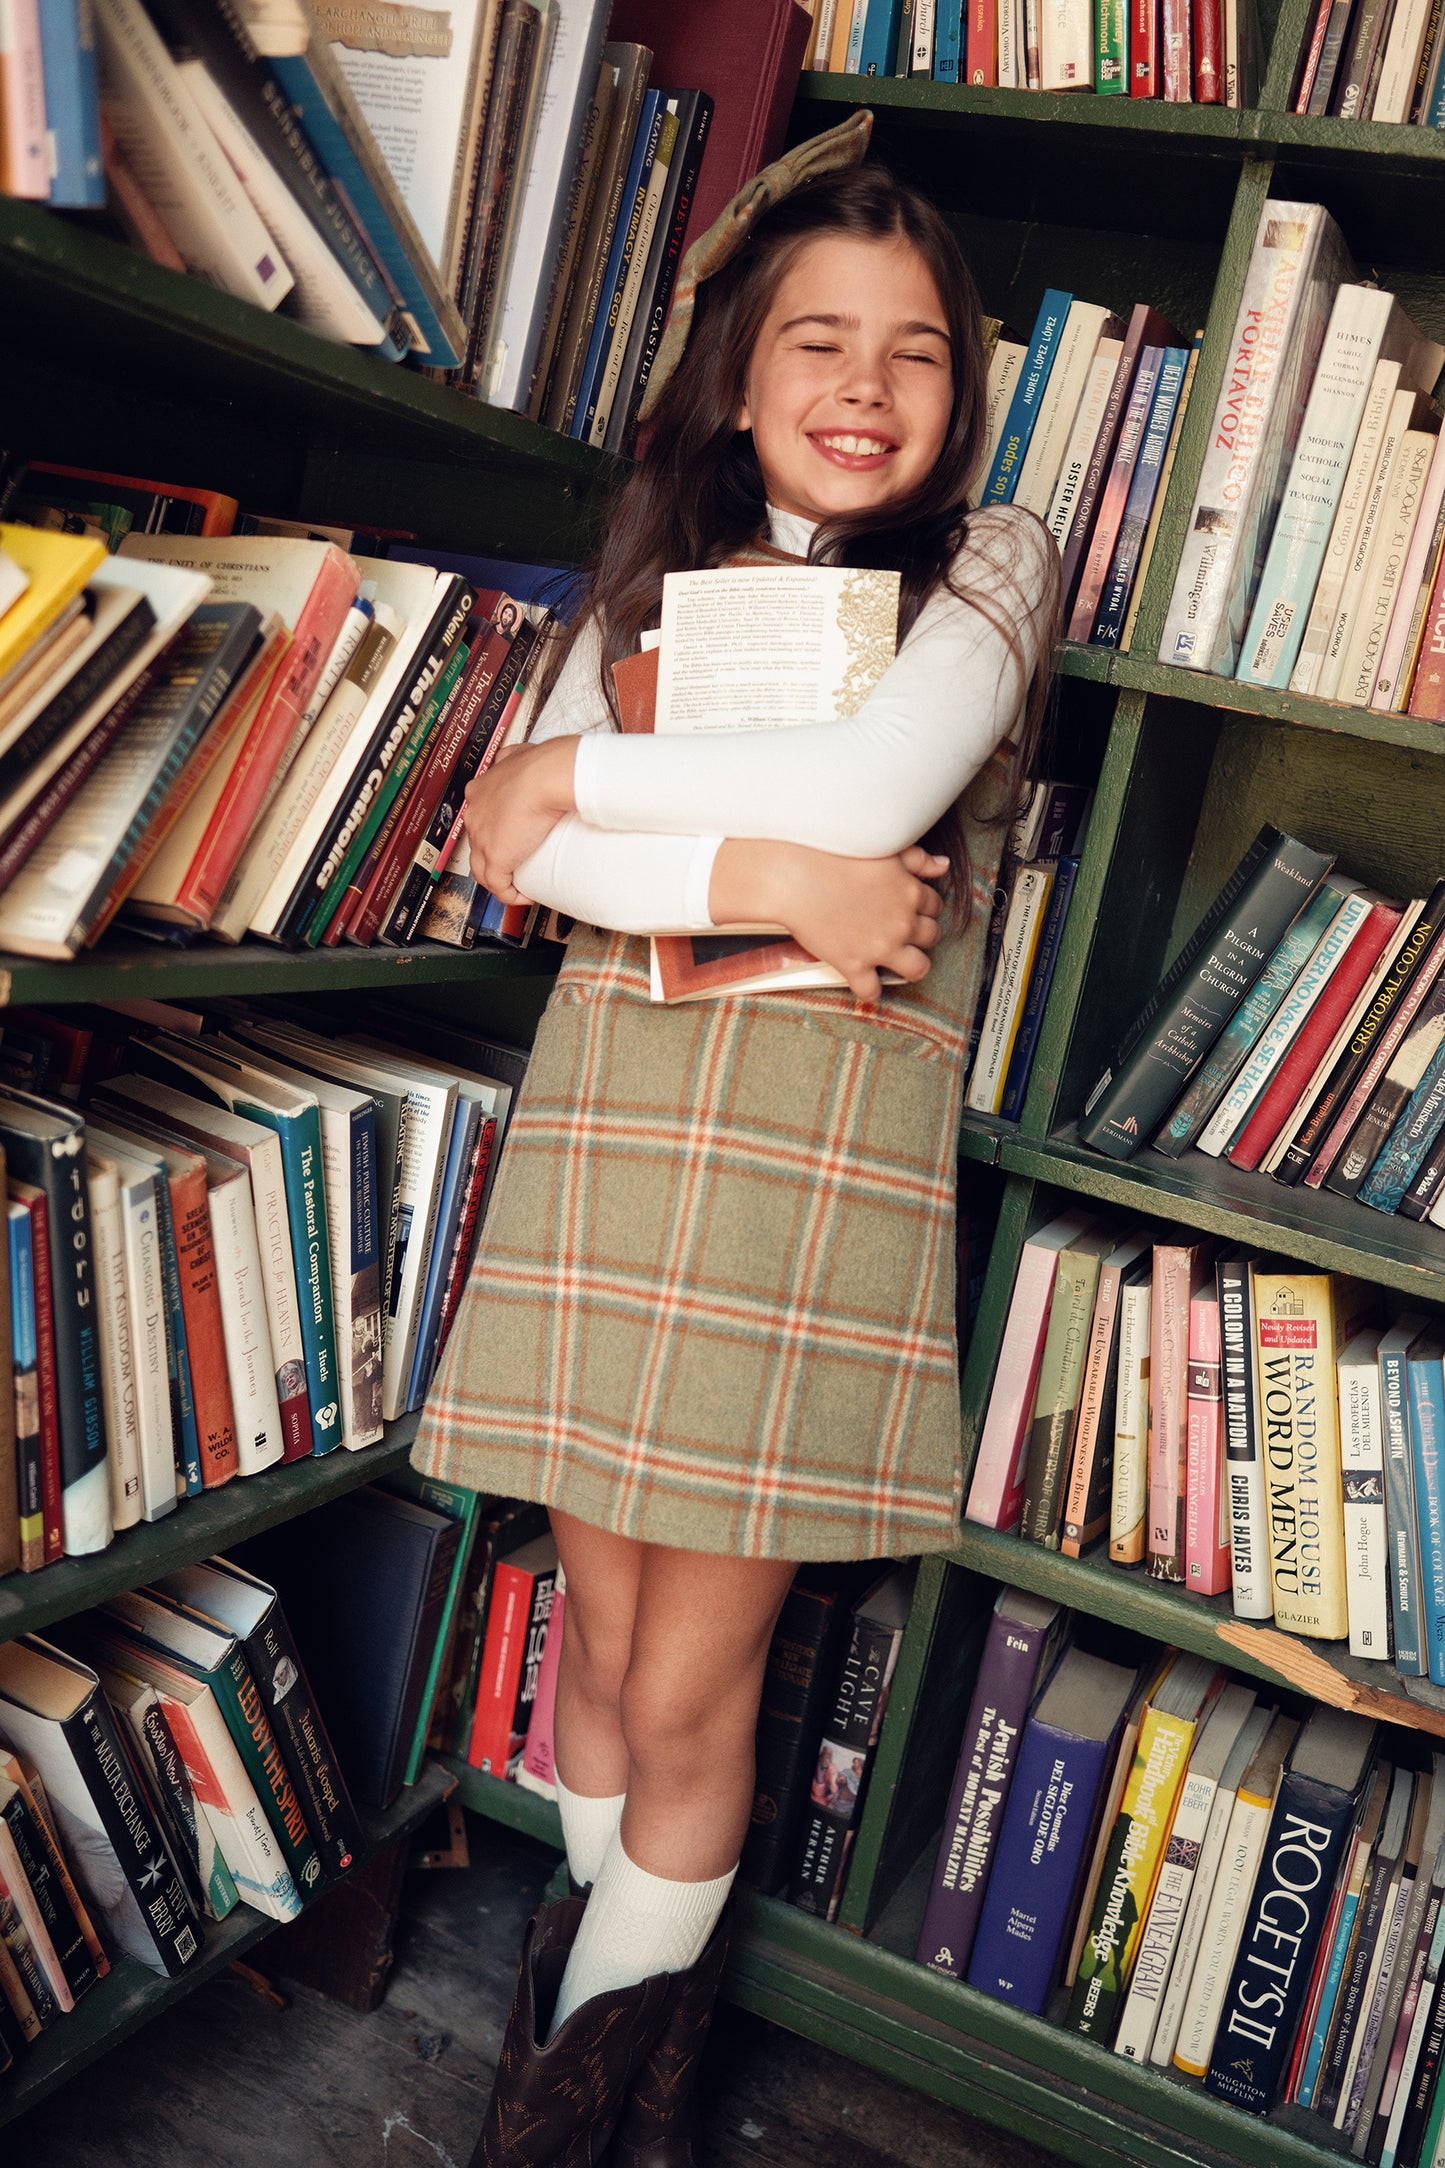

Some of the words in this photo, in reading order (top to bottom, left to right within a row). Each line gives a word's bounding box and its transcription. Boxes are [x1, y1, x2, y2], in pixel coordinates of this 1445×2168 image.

[852, 28, 860, 48] HAIN
[1355, 15, 1374, 60] Pearlman
[1227, 80, 1235, 101] Vida
[645, 112, 663, 168] KEATING
[698, 110, 709, 142] BURKE
[624, 186, 647, 264] INTIMACY
[669, 195, 688, 259] DEVIL
[609, 291, 622, 328] GOD
[640, 306, 664, 387] CASTLE
[1336, 331, 1374, 345] HIMES
[1024, 370, 1039, 404] ANDRÉS
[1034, 344, 1049, 370] LÓPEZ
[1043, 316, 1057, 341] LÓPEZ
[1109, 354, 1130, 400] Believing
[1135, 368, 1154, 393] DEATH
[1159, 363, 1181, 393] DEATH
[1216, 308, 1264, 451] PORTAVOZ
[1128, 404, 1144, 420] THE
[1132, 393, 1148, 404] ON
[1149, 392, 1174, 431] WASHES
[1090, 419, 1112, 466] Revealing
[1116, 420, 1140, 464] BOARDWALK
[1140, 432, 1164, 467] ASHORE
[1298, 453, 1343, 470] CATHOLIC
[1307, 436, 1346, 450] MODERN
[994, 476, 1008, 495] los
[1002, 435, 1020, 472] sapos
[1061, 461, 1081, 503] SISTER
[1086, 467, 1099, 489] God
[1300, 472, 1332, 486] SOCIAL
[1072, 495, 1091, 538] MORAN
[1288, 490, 1333, 508] TEACHING
[1367, 485, 1384, 527] MISTERIO
[1353, 527, 1372, 572] RELIGIOSO
[1187, 542, 1218, 620] Willmington
[442, 594, 473, 648] O'Neill
[1331, 612, 1348, 658] WOODROW
[410, 654, 444, 706] The
[474, 669, 493, 694] The
[489, 635, 528, 712] INTERIOR
[459, 693, 482, 726] Inner
[380, 703, 416, 769] New
[438, 724, 467, 773] Journey
[462, 713, 494, 772] CASTLE
[316, 768, 384, 890] Catholics
[1273, 858, 1314, 888] Weakland
[1022, 904, 1030, 917] THE
[1338, 897, 1364, 928] UN
[1013, 919, 1027, 959] UNIVERSITY
[1224, 929, 1265, 960] PILGRIM
[1248, 927, 1259, 938] A
[1306, 923, 1348, 980] LIDER
[1010, 959, 1018, 970] OF
[1207, 955, 1248, 985] PILGRIM
[1227, 951, 1238, 961] IN
[1003, 970, 1016, 1005] CHICAGO
[1199, 969, 1240, 998] CHURCH
[1293, 972, 1320, 1003] NO
[1348, 972, 1403, 1056] CRISTOBAL
[1393, 919, 1433, 976] COLON
[996, 1005, 1008, 1035] SPANISH
[1263, 995, 1304, 1048] NACE,
[986, 1035, 1001, 1079] DICTIONARY
[1252, 1041, 1276, 1069] SE
[1226, 1063, 1263, 1112] HACE
[1299, 1126, 1316, 1145] Kay
[1309, 1090, 1337, 1128] Brigham
[301, 1146, 311, 1177] The
[361, 1131, 369, 1168] JEWISH
[1287, 1151, 1304, 1165] CLIE
[303, 1180, 319, 1239] Pastoral
[362, 1170, 370, 1208] PUBLIC
[265, 1190, 284, 1267] PRACTICE
[363, 1208, 371, 1254] CULTURE
[234, 1266, 250, 1308] Bread
[272, 1270, 284, 1284] for
[308, 1241, 324, 1324] Companion
[1100, 1277, 1112, 1302] DELIO
[1221, 1276, 1239, 1288] A
[275, 1289, 293, 1349] HEAVEN
[1221, 1292, 1244, 1353] COLONY
[80, 1327, 96, 1391] WILLIAM
[241, 1346, 257, 1397] Journey
[318, 1349, 328, 1382] Huels
[1224, 1356, 1244, 1374] IN
[1226, 1376, 1244, 1388] A
[1386, 1359, 1400, 1407] BEYOND
[84, 1397, 100, 1450] GIBSON
[290, 1412, 300, 1446] SOPHIA
[1225, 1391, 1248, 1449] NATION
[1262, 1354, 1295, 1471] WORD
[1292, 1353, 1320, 1485] RANDOM
[1388, 1409, 1403, 1459] ASPIRIN
[1115, 1451, 1131, 1526] NOUWEN
[1230, 1473, 1250, 1520] CHRIS
[1232, 1525, 1253, 1574] HAYES
[1269, 1480, 1299, 1597] MENU
[1297, 1497, 1322, 1596] HOUSE
[1356, 1516, 1371, 1550] Hogue
[1357, 1554, 1371, 1580] John
[1277, 1609, 1320, 1625] GLAZIER
[1006, 1634, 1029, 1653] Fein
[232, 1674, 267, 1724] LED
[833, 1656, 861, 1730] LIGHT
[853, 1665, 880, 1726] CAVE
[88, 1724, 102, 1743] THE
[247, 1714, 276, 1753] BY
[984, 1717, 1015, 1783] Jewish
[91, 1737, 125, 1789] MALTA
[256, 1741, 291, 1795] THE
[1049, 1758, 1065, 1784] DEL
[1130, 1725, 1178, 1820] Handbook
[110, 1781, 154, 1855] EXCHANGE
[271, 1780, 311, 1849] SPIRIT
[1040, 1783, 1059, 1821] SIGLO
[801, 1818, 823, 1880] HERMAN
[957, 1786, 999, 1894] Possibilities
[1036, 1819, 1049, 1838] DE
[1117, 1818, 1151, 1869] Bible
[815, 1826, 836, 1884] ARTHUR
[1029, 1838, 1045, 1865] ORO
[166, 1877, 188, 1921] STEVE
[1164, 1869, 1183, 1891] THE
[148, 1895, 175, 1937] BERRY
[1085, 1864, 1140, 1964] Knowledge
[1233, 1811, 1334, 2018] ROGET'S
[1392, 1887, 1409, 1928] THOMAS
[1133, 1890, 1183, 2003] ENNEAGRAM
[1382, 1928, 1399, 1969] MERTON
[1224, 2008, 1278, 2050] II
[1210, 2069, 1266, 2098] HOUGHTON
[1218, 2081, 1255, 2101] MIFFLIN
